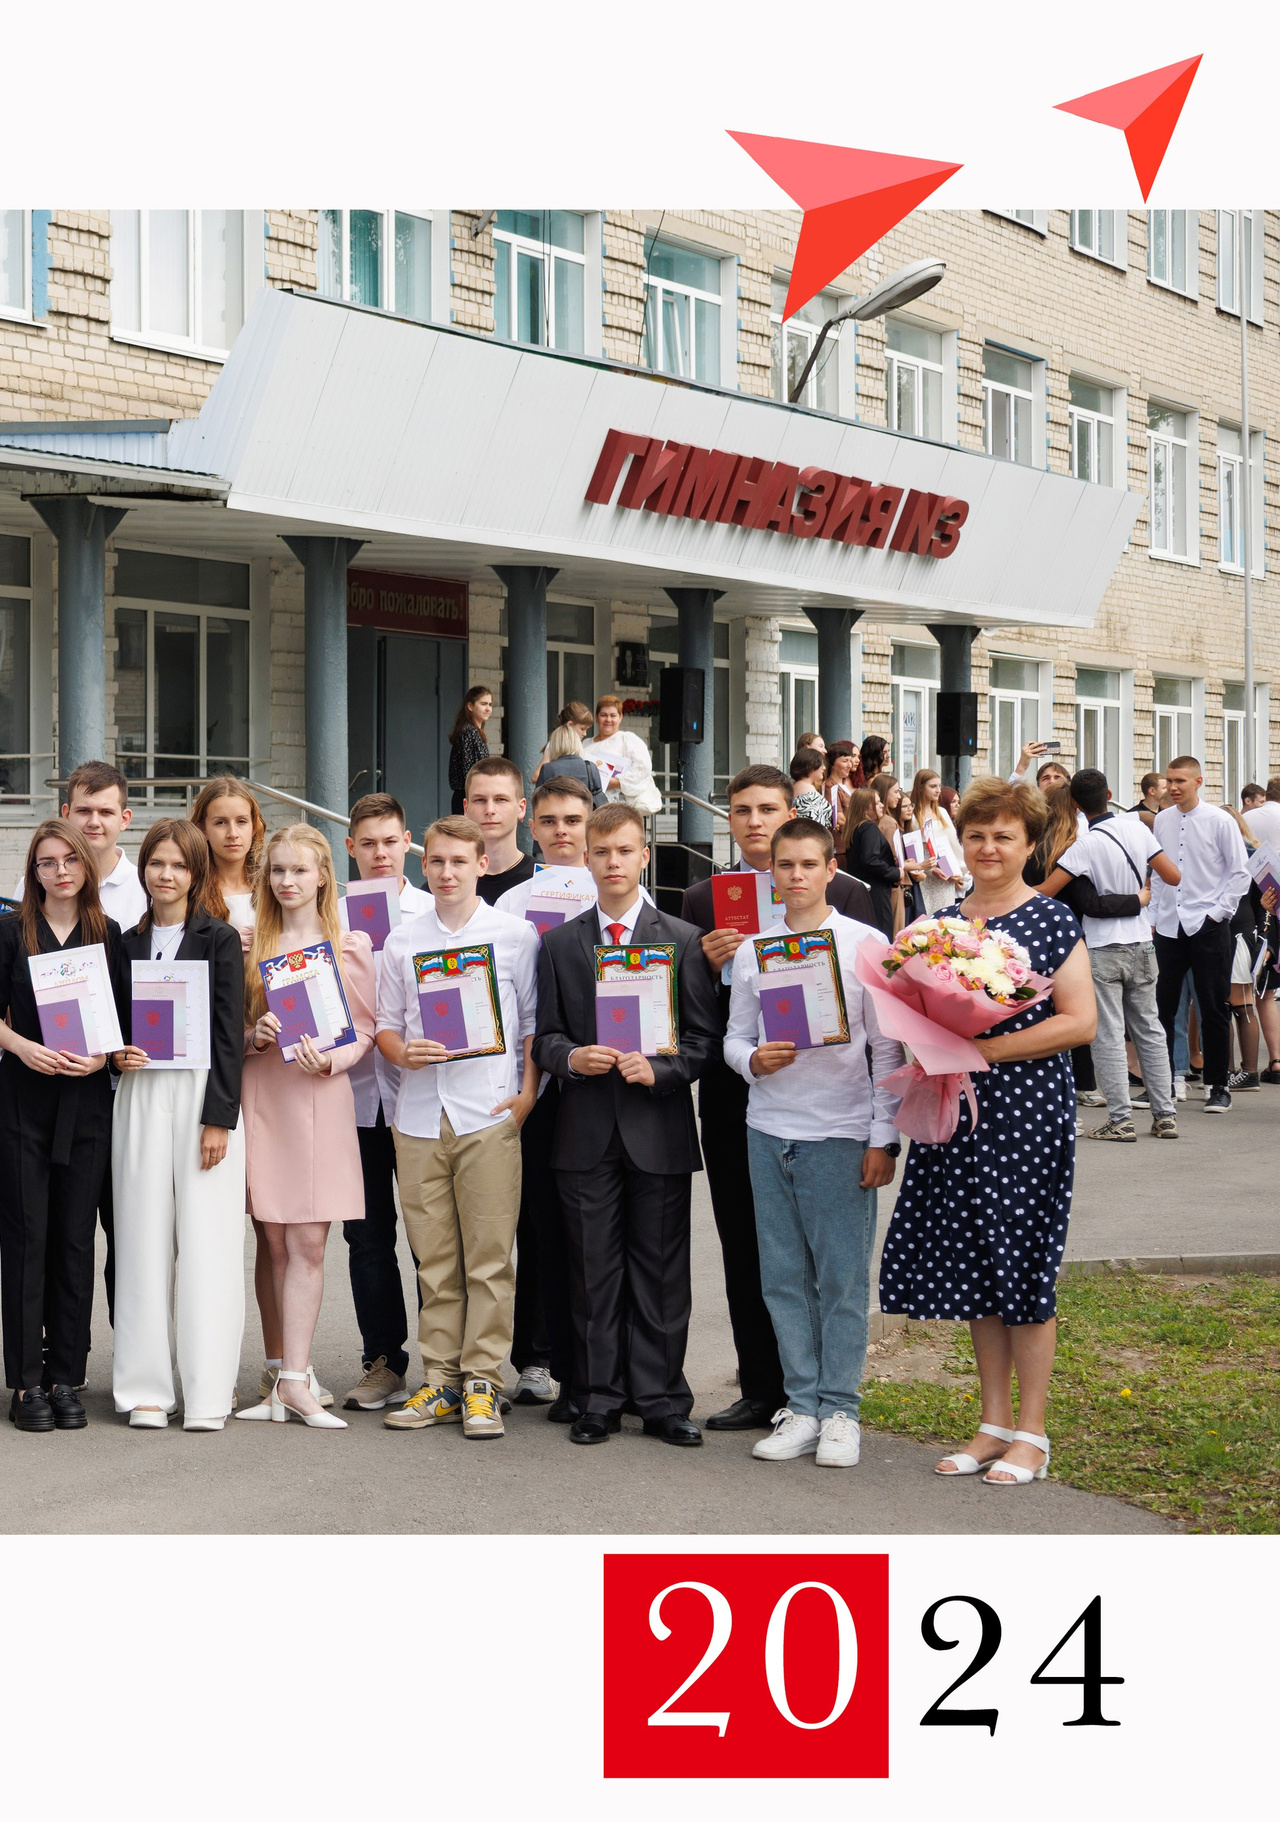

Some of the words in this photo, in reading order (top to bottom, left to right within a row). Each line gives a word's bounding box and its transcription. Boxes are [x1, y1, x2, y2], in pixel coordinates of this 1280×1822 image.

[584, 428, 904, 550] ГИМНАЗИЯ
[540, 890, 595, 902] СЕРТИФИКАТ
[281, 969, 320, 986] ГРАМОТА
